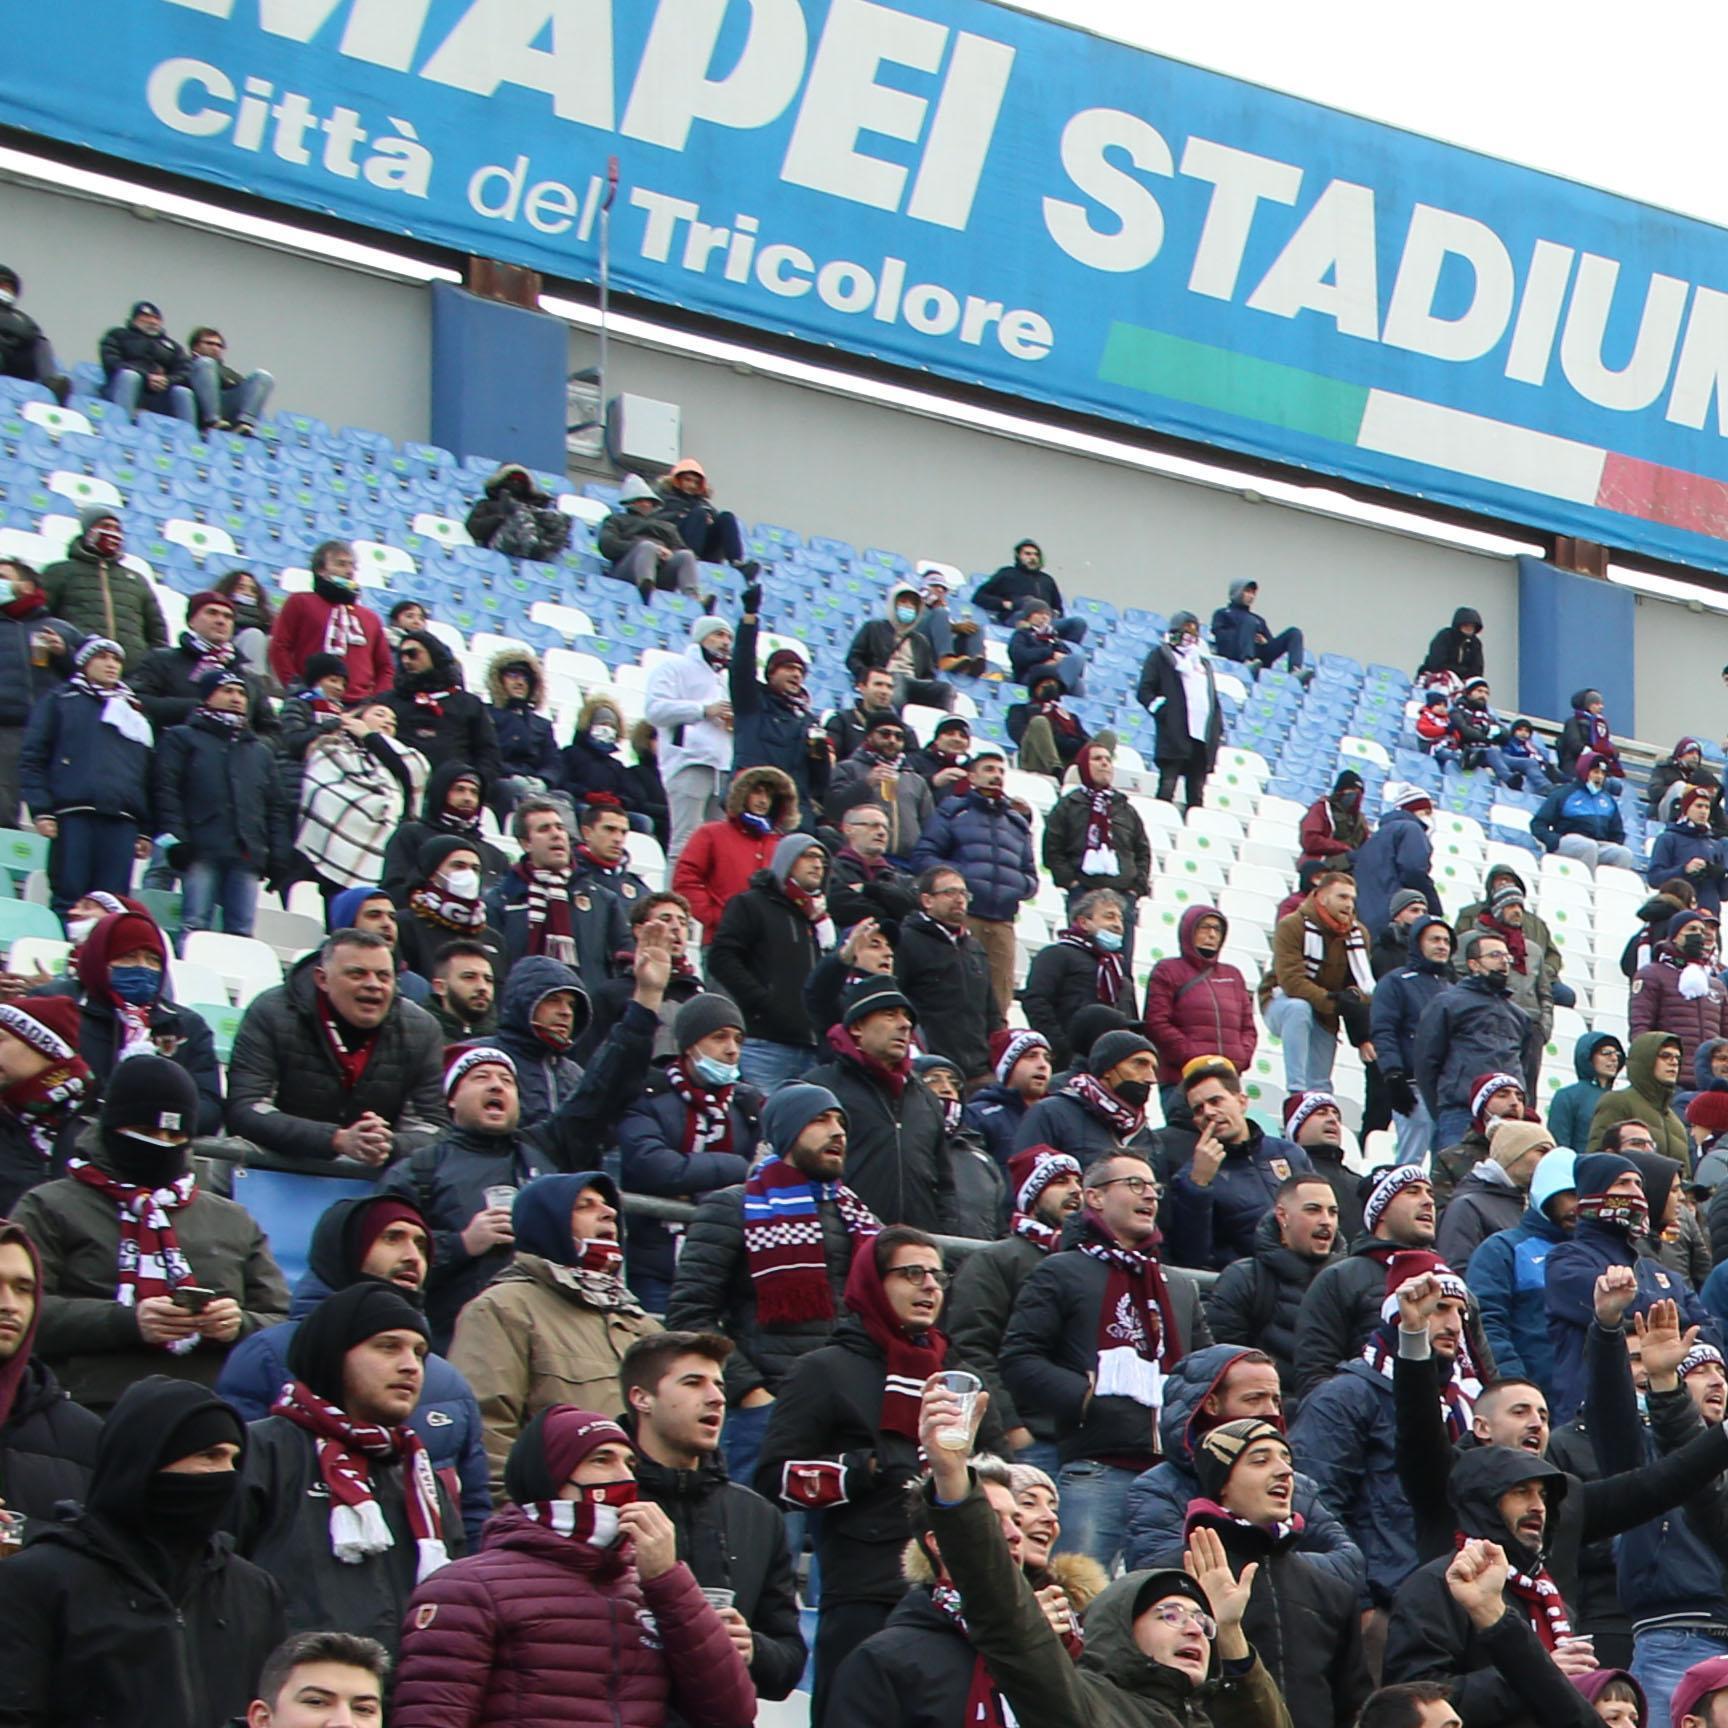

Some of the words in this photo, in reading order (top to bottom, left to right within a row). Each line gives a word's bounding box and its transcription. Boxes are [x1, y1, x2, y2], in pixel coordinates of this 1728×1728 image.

[145, 56, 434, 200] Città
[466, 155, 604, 242] del
[630, 186, 1054, 362] Tricolore
[0, 1007, 64, 1059] UADRE
